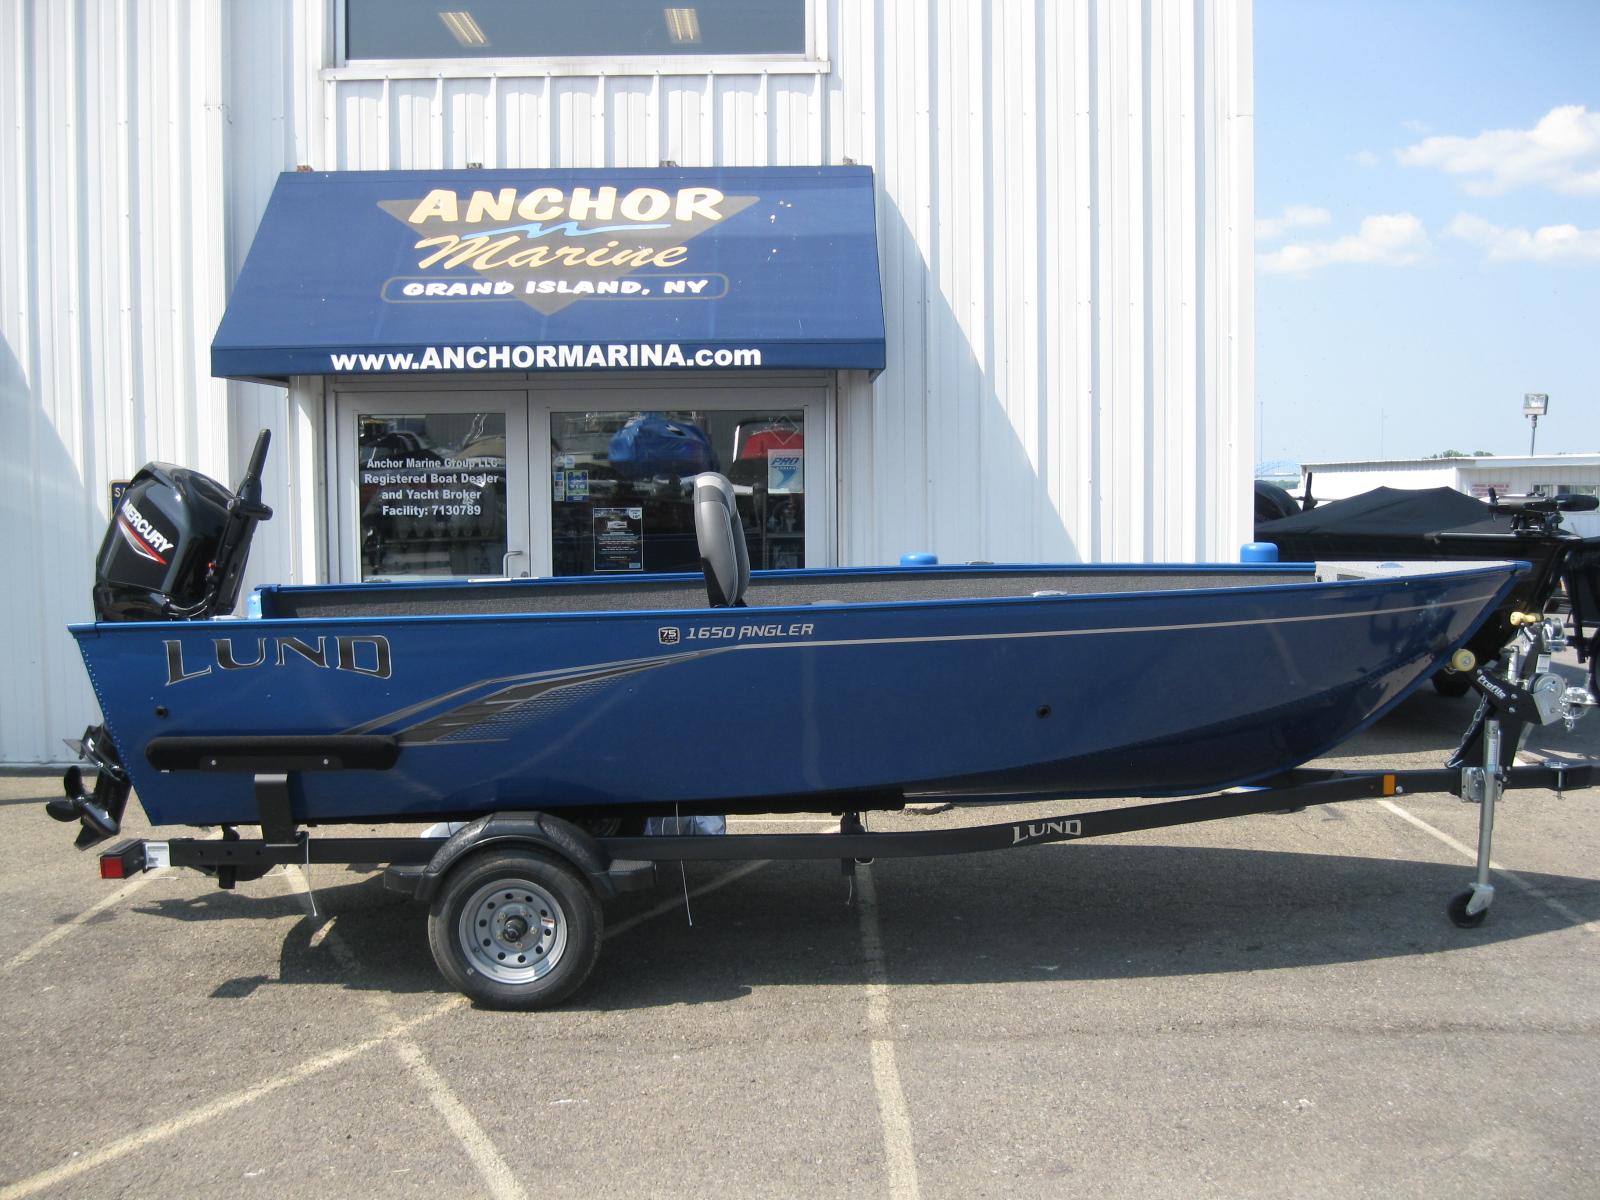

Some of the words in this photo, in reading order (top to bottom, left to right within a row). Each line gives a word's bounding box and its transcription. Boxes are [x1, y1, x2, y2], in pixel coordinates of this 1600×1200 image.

[408, 187, 724, 224] ANCHOR
[414, 235, 688, 270] Marine
[403, 282, 514, 296] GRAND
[525, 280, 650, 295] ISLAND,
[664, 280, 708, 293] NY
[330, 344, 761, 371] www.ANCHORMARINA.com
[366, 458, 403, 468] Anchor
[406, 458, 441, 468] Marine
[444, 458, 475, 470] Group
[364, 473, 427, 485] Registered
[430, 473, 457, 483] Boat
[461, 473, 499, 483] Dealer
[381, 489, 403, 499] and
[406, 489, 440, 499] Yacht
[442, 489, 482, 499] Broker
[382, 505, 428, 517] Facility:
[432, 505, 481, 515] 7130789
[122, 497, 174, 552] MERCURY
[661, 629, 677, 637] 75
[686, 627, 736, 639] 1650
[738, 623, 814, 640] ANGLER
[162, 635, 392, 686] LUND
[1478, 674, 1507, 699] Profile
[1012, 819, 1081, 844] LUND
